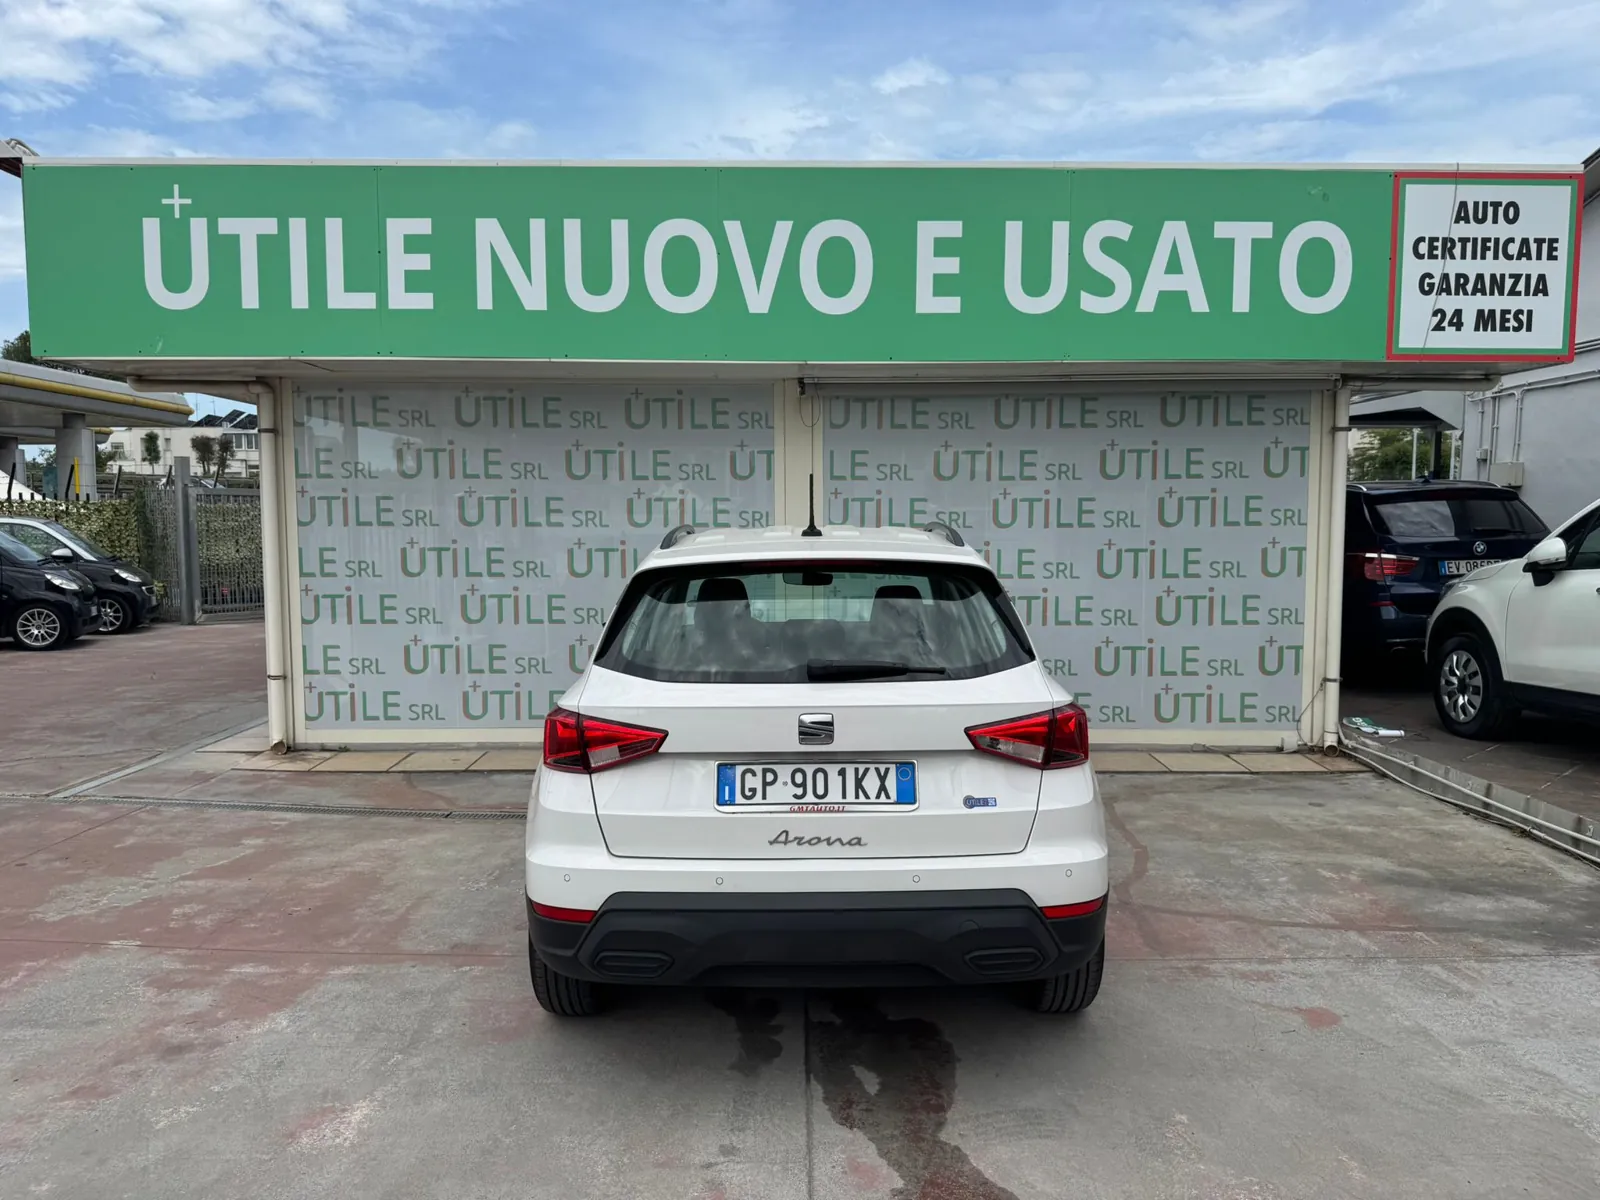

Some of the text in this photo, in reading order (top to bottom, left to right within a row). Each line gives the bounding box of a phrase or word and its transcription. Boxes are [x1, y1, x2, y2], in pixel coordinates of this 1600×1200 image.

[1453, 200, 1520, 225] AUTO
[1412, 236, 1559, 261] CERTIFICATE
[475, 217, 874, 315] NUOVO
[916, 220, 963, 314] E
[1003, 219, 1353, 315] USATO
[1418, 272, 1549, 297] GARANZIA
[1431, 308, 1533, 333] 24 MESI
[398, 410, 436, 428] SRL
[569, 410, 608, 429] SRL
[737, 411, 774, 429] SRL
[937, 411, 975, 429] SRL
[1106, 410, 1144, 428] SRL
[1272, 408, 1310, 426] SRL
[341, 461, 379, 479] SRL
[510, 462, 549, 480] SRL
[678, 463, 716, 481] SRL
[876, 463, 914, 481] SRL
[1044, 463, 1082, 481] SRL
[1211, 461, 1249, 479] SRL
[402, 509, 439, 527] SRL
[571, 510, 609, 528] SRL
[738, 510, 774, 528] SRL
[1103, 510, 1141, 528] SRL
[1270, 508, 1307, 526] SRL
[344, 560, 382, 578] SRL
[512, 560, 551, 578] SRL
[1042, 562, 1080, 579] SRL
[1208, 561, 1247, 578] SRL
[405, 607, 443, 624] SRL
[1100, 609, 1138, 626] SRL
[1267, 608, 1304, 625] SRL
[348, 658, 386, 675] SRL
[514, 657, 552, 674] SRL
[1207, 659, 1244, 676] SRL
[408, 704, 446, 721] SRL
[1099, 705, 1136, 723] SRL
[1265, 705, 1302, 723] SRL
[768, 829, 868, 847] Arona
